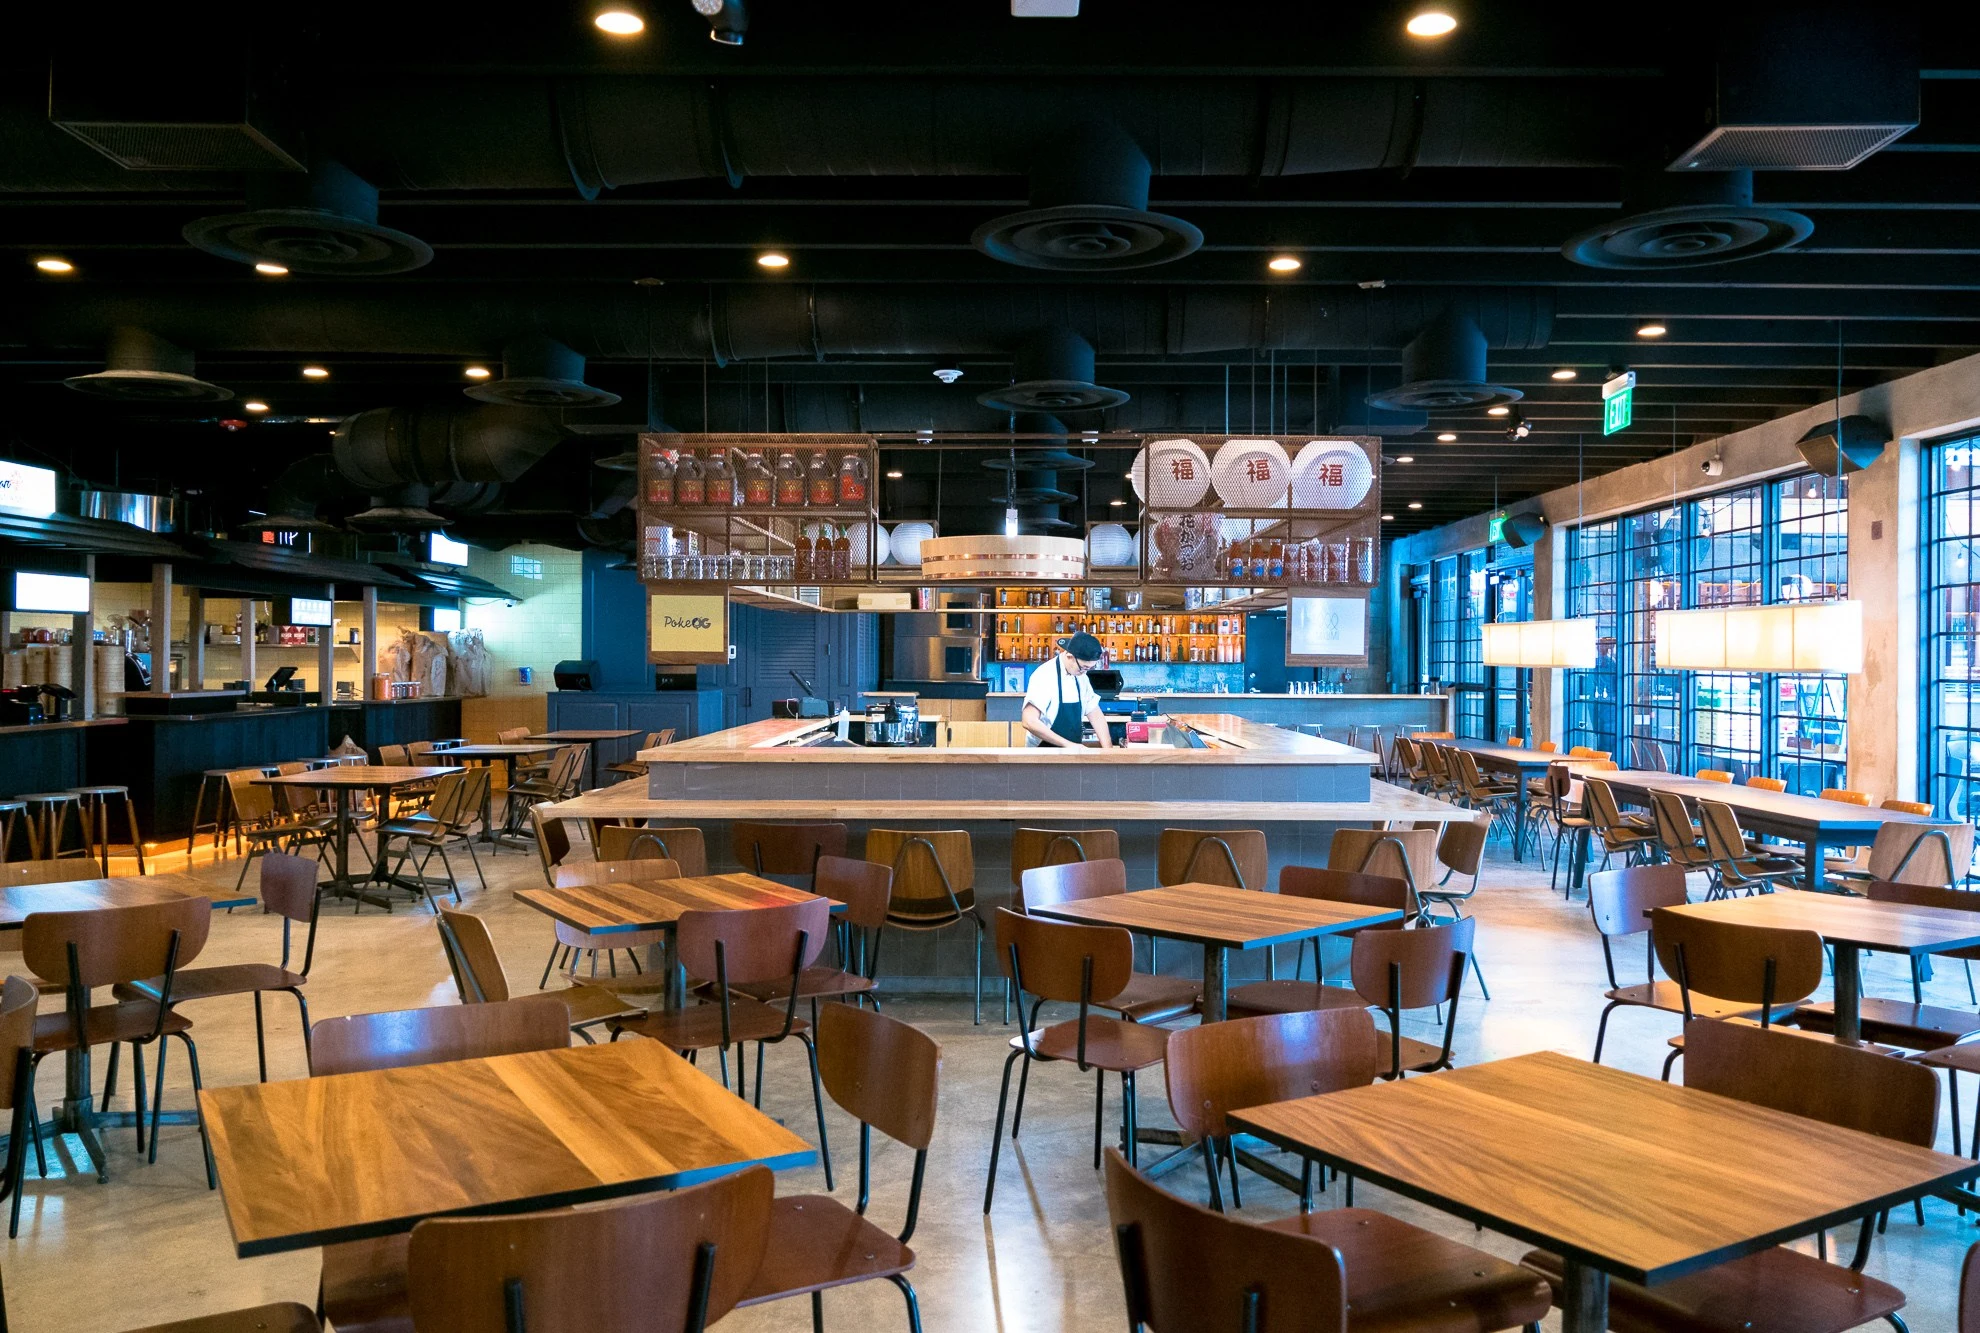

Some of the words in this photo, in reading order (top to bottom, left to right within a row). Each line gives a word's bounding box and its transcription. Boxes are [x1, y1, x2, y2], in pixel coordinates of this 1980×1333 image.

[1609, 393, 1627, 429] EXIT
[1171, 458, 1194, 481] 福
[1247, 458, 1271, 482] 福
[1318, 463, 1343, 487] 福
